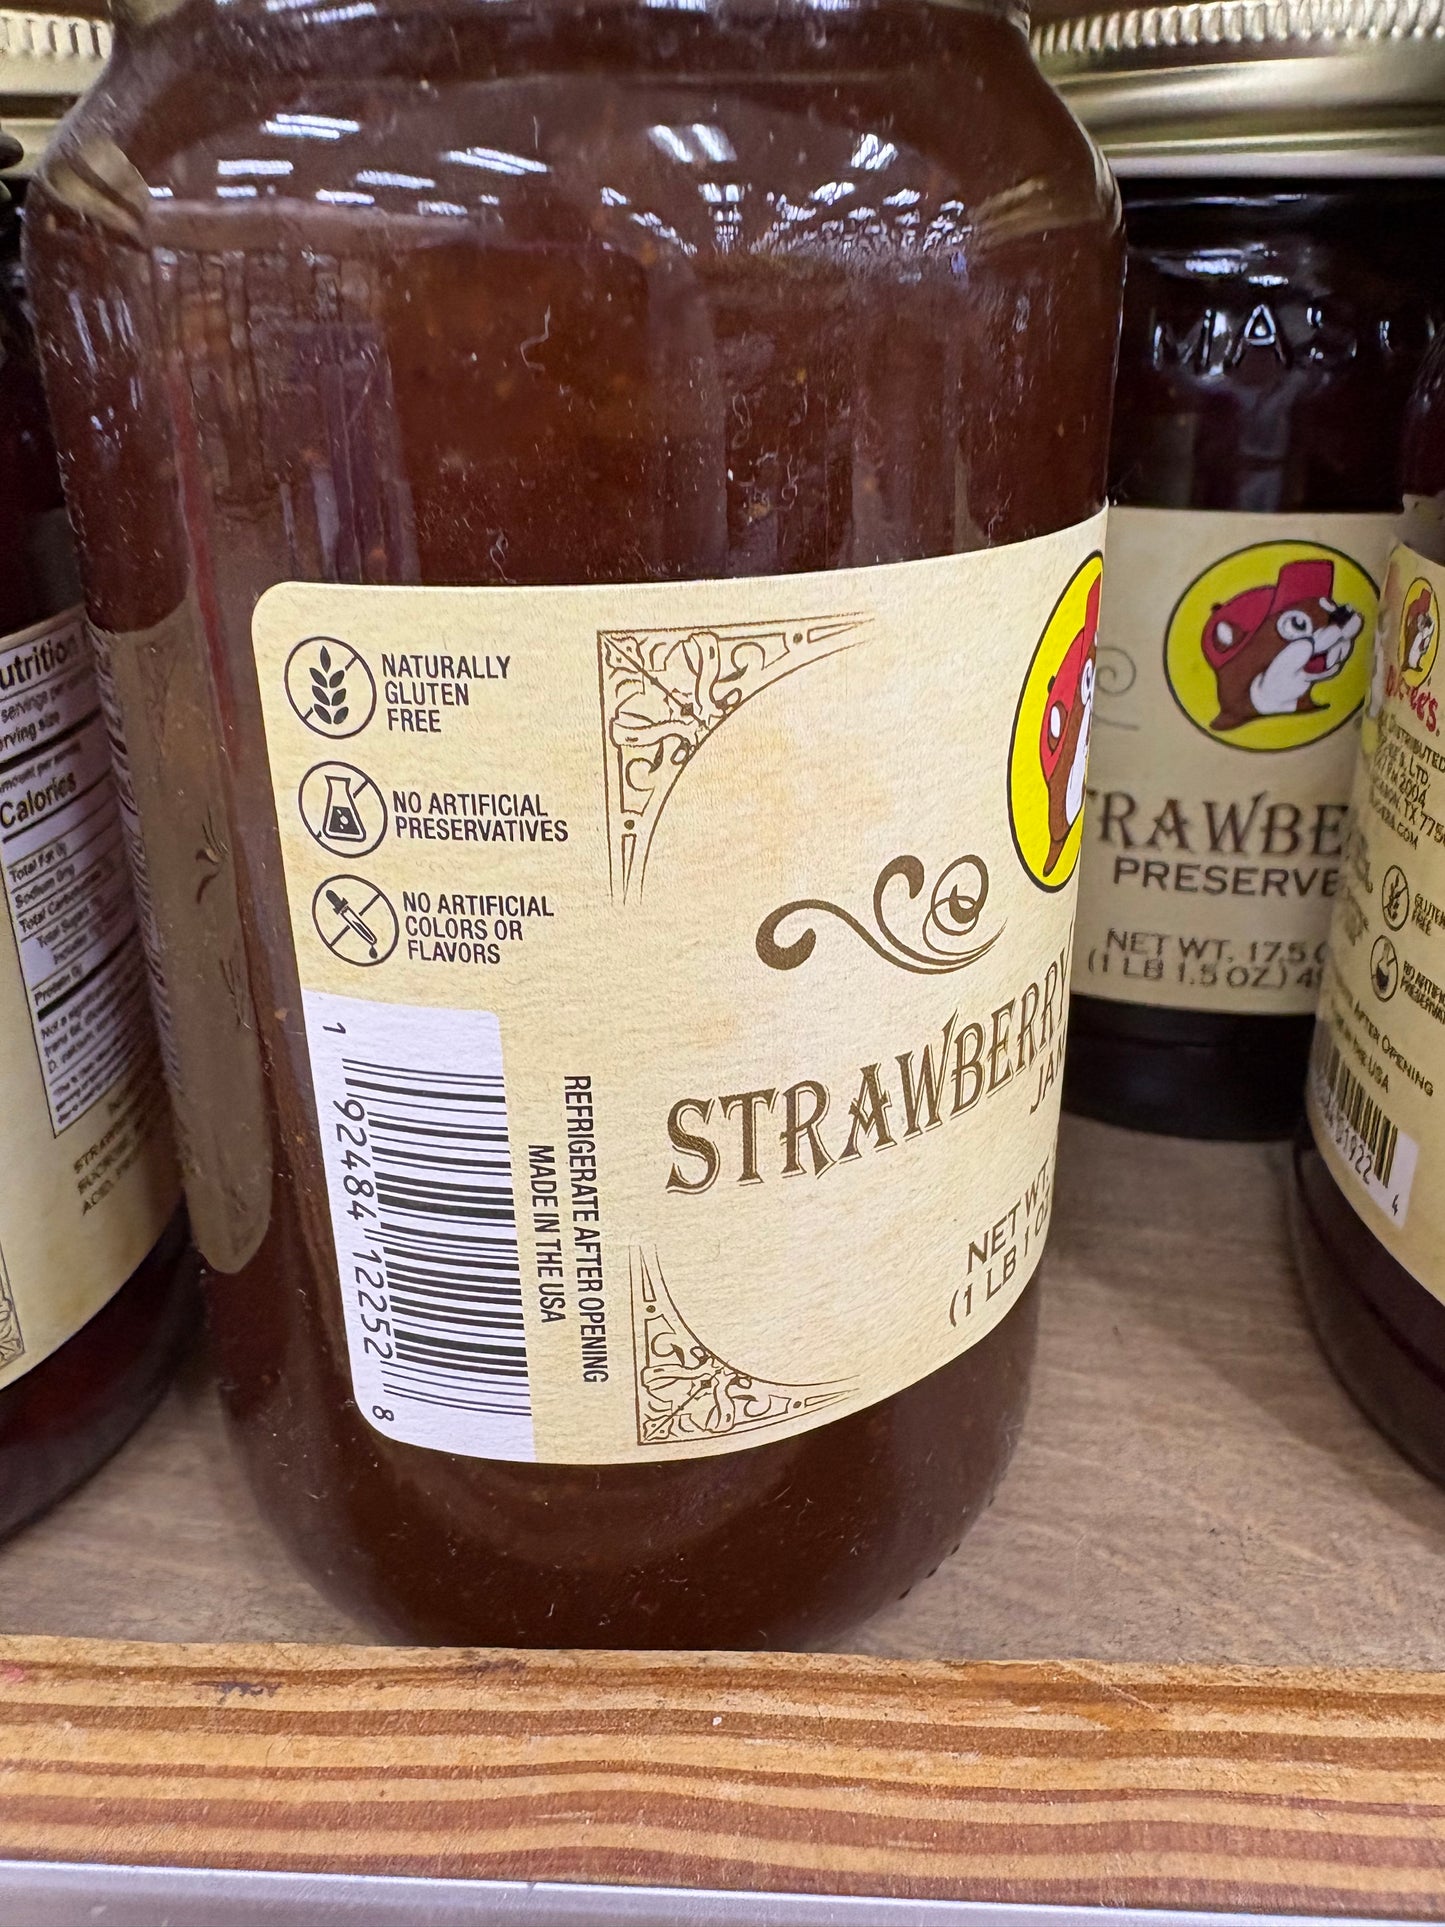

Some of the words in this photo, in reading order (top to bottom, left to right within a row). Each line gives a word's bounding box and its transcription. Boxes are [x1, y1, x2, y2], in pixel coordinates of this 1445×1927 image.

[382, 653, 511, 680] NATURALLY
[384, 682, 469, 706] GLUTEN
[387, 708, 441, 733] FREE
[393, 790, 422, 815] NO
[428, 793, 549, 818] ARTIFICIAL
[395, 816, 569, 843] PRESERVATIVES
[403, 891, 431, 915] NO
[437, 894, 555, 917] ARTIFICIAL
[405, 916, 488, 940] COLORS
[493, 918, 523, 941] OR
[1106, 927, 1169, 957] NET
[407, 939, 501, 964] FLAVORS
[1123, 956, 1164, 981] LB
[321, 1022, 347, 1035] 1
[665, 946, 1071, 1196] STRAWBERRY
[332, 1099, 377, 1221] 92484
[564, 1074, 600, 1222] REFRIGERATE
[528, 1144, 559, 1208] MADE
[533, 1212, 561, 1233] IN
[967, 1197, 1021, 1276] NET
[535, 1237, 564, 1279] THE
[574, 1226, 603, 1293] AFTER
[949, 1283, 973, 1327] (1
[985, 1244, 1017, 1302] LB
[352, 1249, 394, 1360] 12252
[538, 1283, 567, 1324] USA
[579, 1296, 609, 1384] OPENING
[372, 1404, 395, 1423] 8
